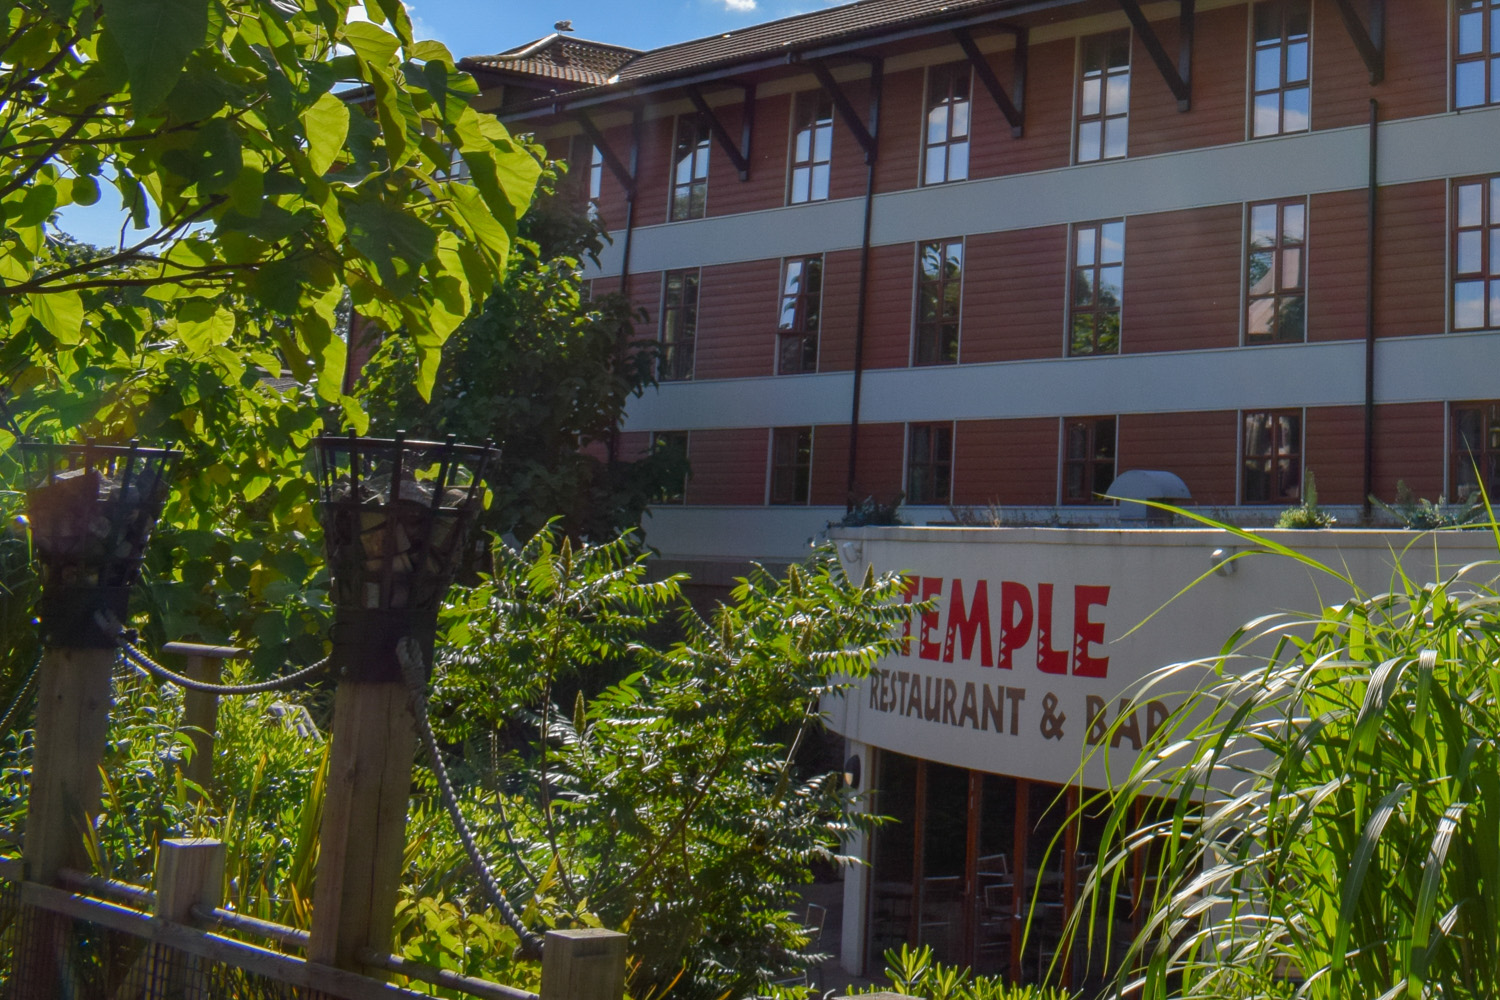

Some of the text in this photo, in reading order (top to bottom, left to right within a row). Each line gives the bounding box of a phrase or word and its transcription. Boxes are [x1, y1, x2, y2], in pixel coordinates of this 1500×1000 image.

[898, 575, 1111, 678] TEMPLE
[869, 667, 1170, 752] RESTAURANT & BAR
